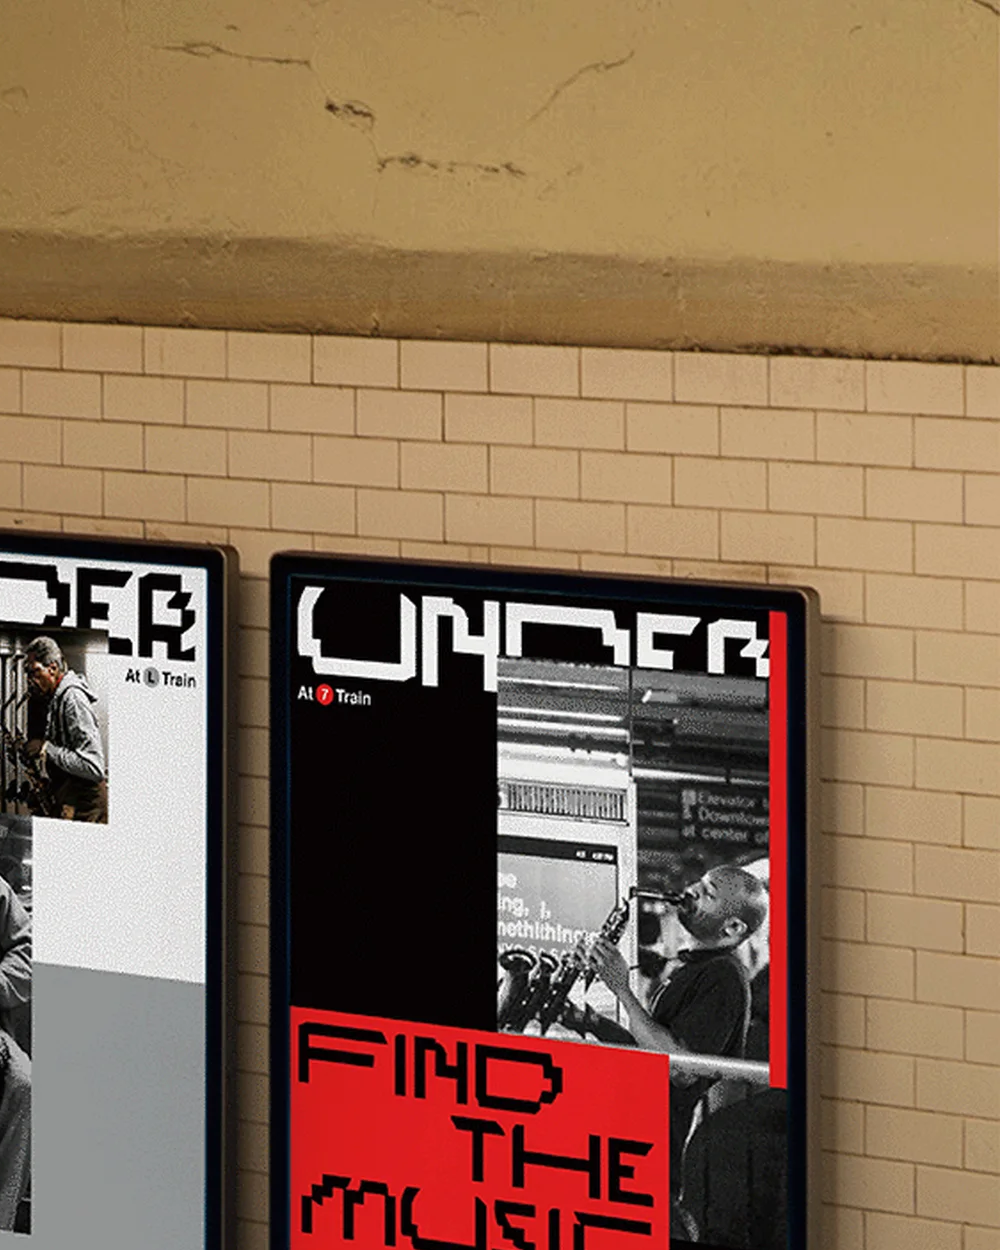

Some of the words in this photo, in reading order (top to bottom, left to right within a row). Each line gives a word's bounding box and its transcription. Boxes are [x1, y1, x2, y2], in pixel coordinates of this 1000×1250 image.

[125, 668, 140, 684] At
[162, 671, 196, 688] Train
[297, 685, 314, 701] At
[335, 688, 371, 706] Train
[299, 1021, 563, 1115] FIND
[450, 1115, 655, 1208] THE
